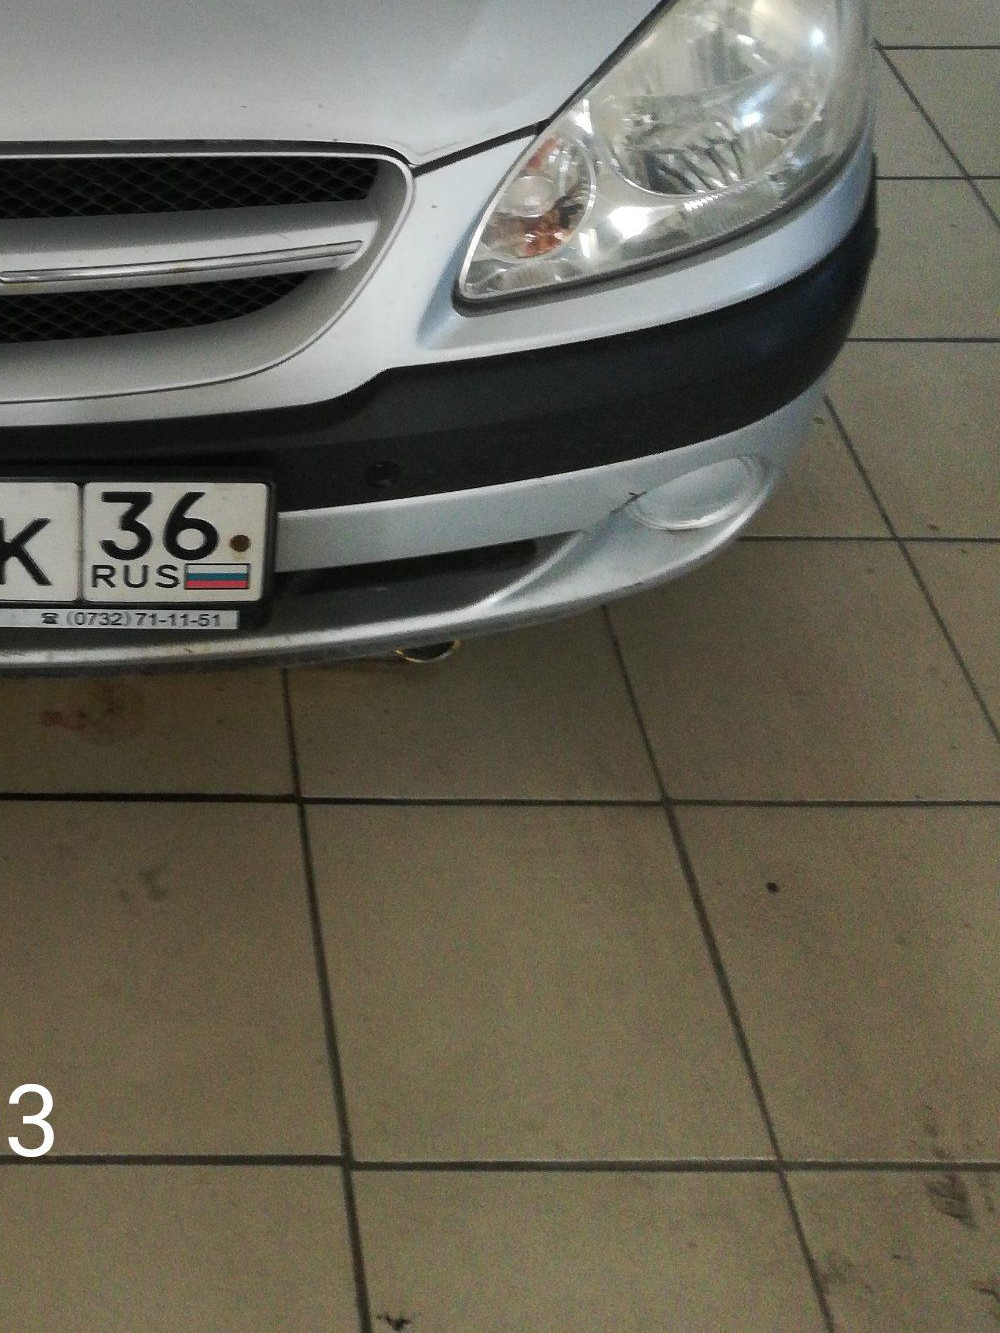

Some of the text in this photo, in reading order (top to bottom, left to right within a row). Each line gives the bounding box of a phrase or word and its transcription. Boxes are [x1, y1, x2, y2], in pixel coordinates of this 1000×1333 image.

[100, 491, 220, 561] 36
[91, 564, 181, 589] RUS
[66, 611, 221, 627] (0732) 71-11-51
